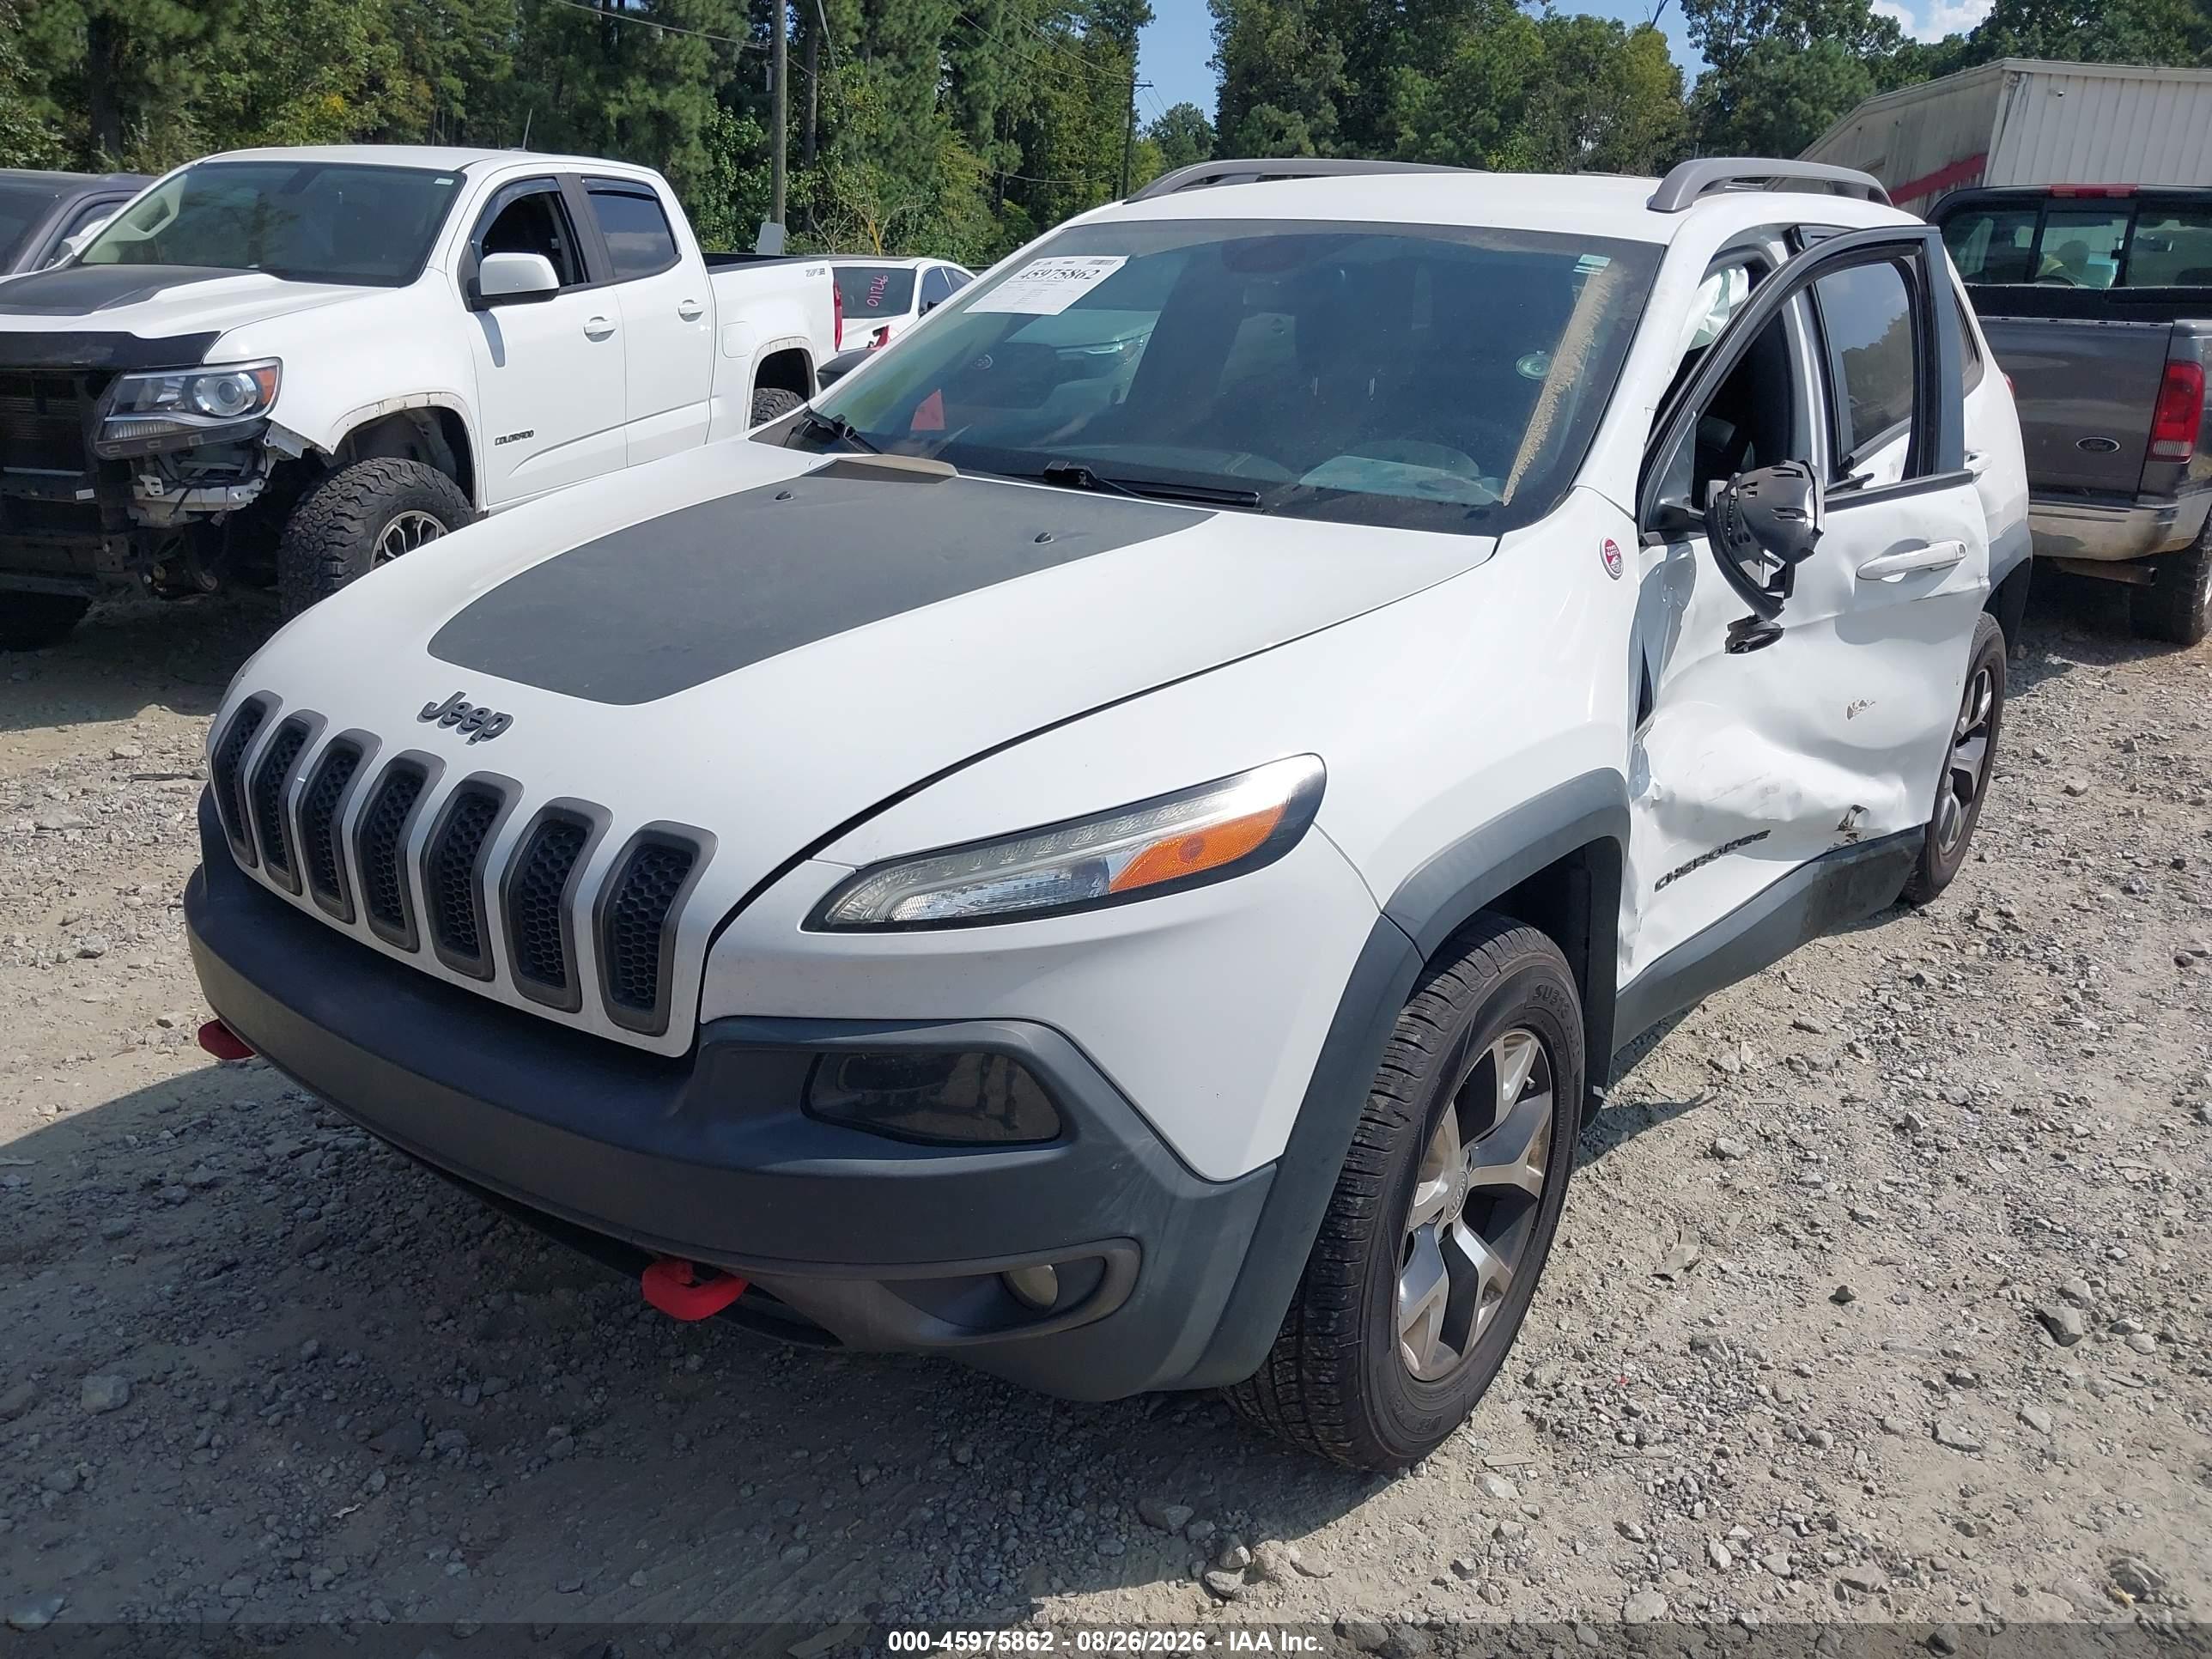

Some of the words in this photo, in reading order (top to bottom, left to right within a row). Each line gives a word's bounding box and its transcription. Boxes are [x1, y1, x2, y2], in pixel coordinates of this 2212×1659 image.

[1019, 268, 1101, 281] 45975862
[495, 429, 534, 446] COLORADO
[419, 690, 514, 744] Jeep
[1654, 830, 1771, 892] CHEROKEE
